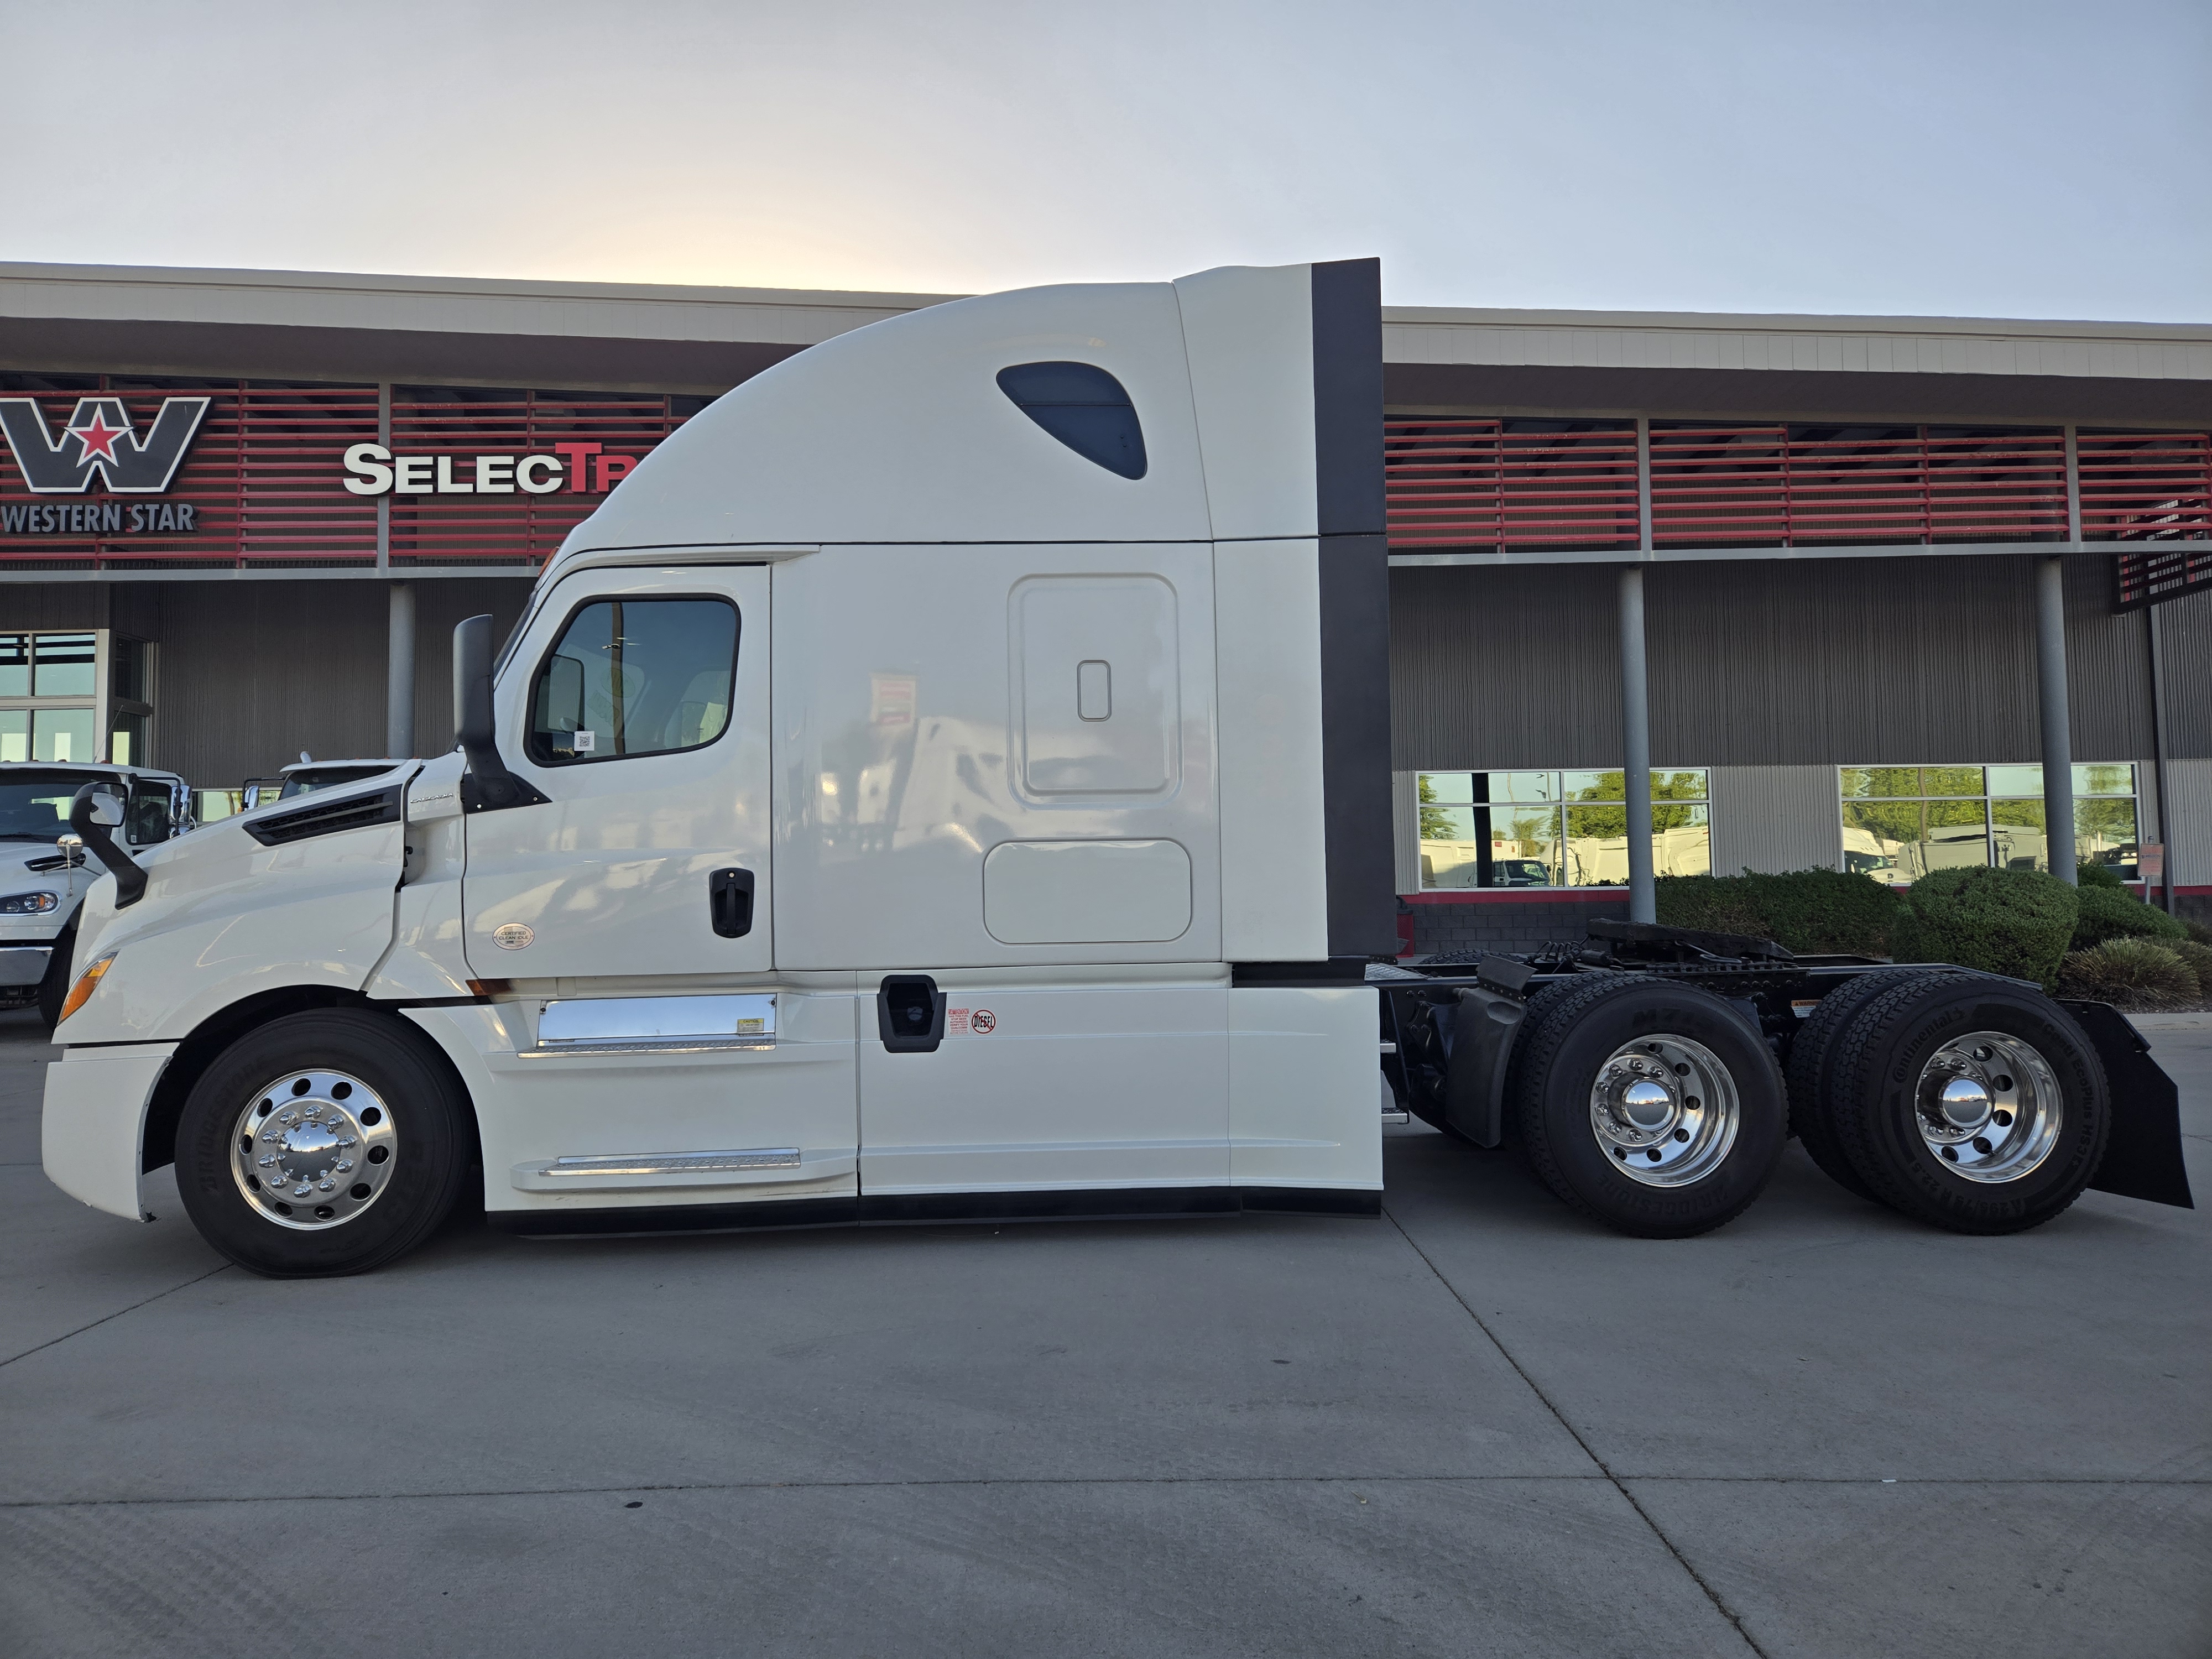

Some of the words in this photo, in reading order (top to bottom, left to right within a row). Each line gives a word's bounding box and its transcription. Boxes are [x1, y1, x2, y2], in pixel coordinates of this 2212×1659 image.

[0, 504, 122, 533] WESTERN
[130, 503, 195, 531] STAR
[974, 1015, 993, 1027] DIESEL
[1893, 1009, 1953, 1083] Continental
